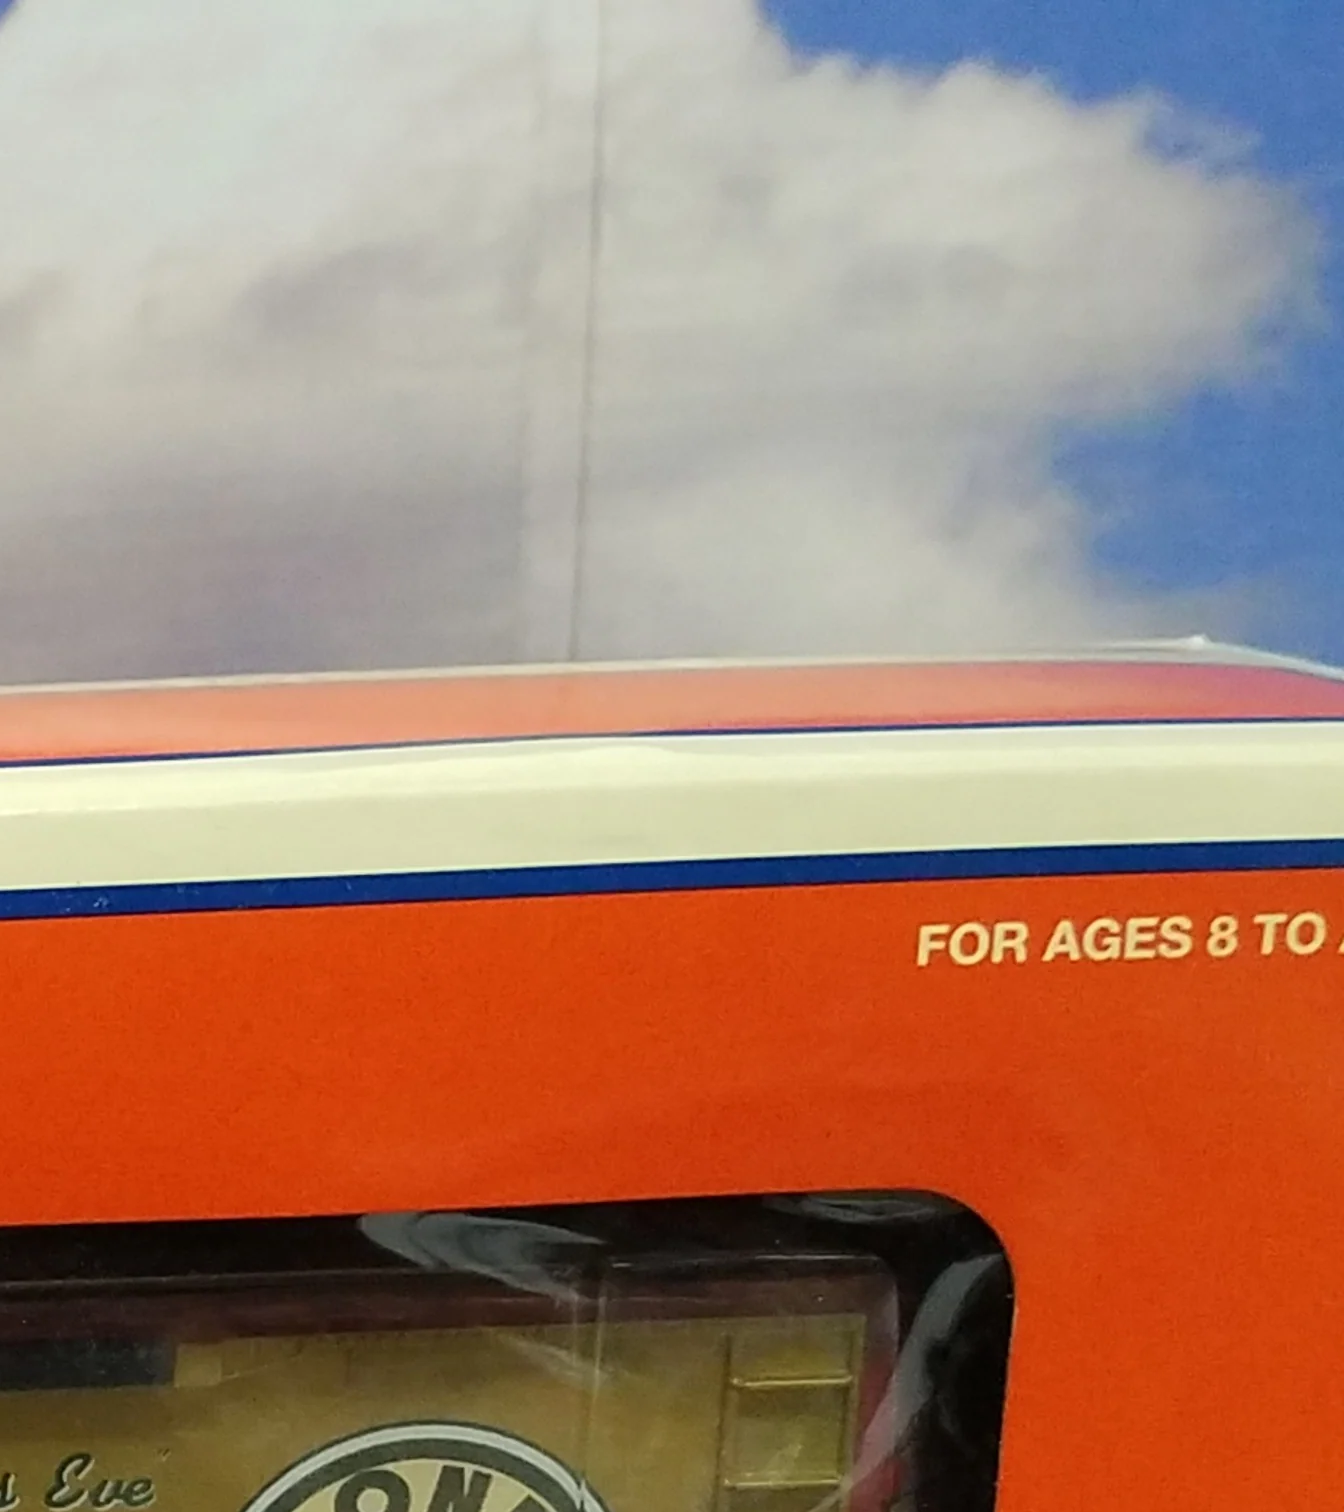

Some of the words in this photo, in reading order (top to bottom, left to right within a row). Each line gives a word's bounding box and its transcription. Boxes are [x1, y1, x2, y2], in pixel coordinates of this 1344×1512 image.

[916, 921, 1030, 967] FOR
[1041, 915, 1194, 963] AGES
[1205, 914, 1240, 958] 8
[1253, 911, 1327, 956] TO
